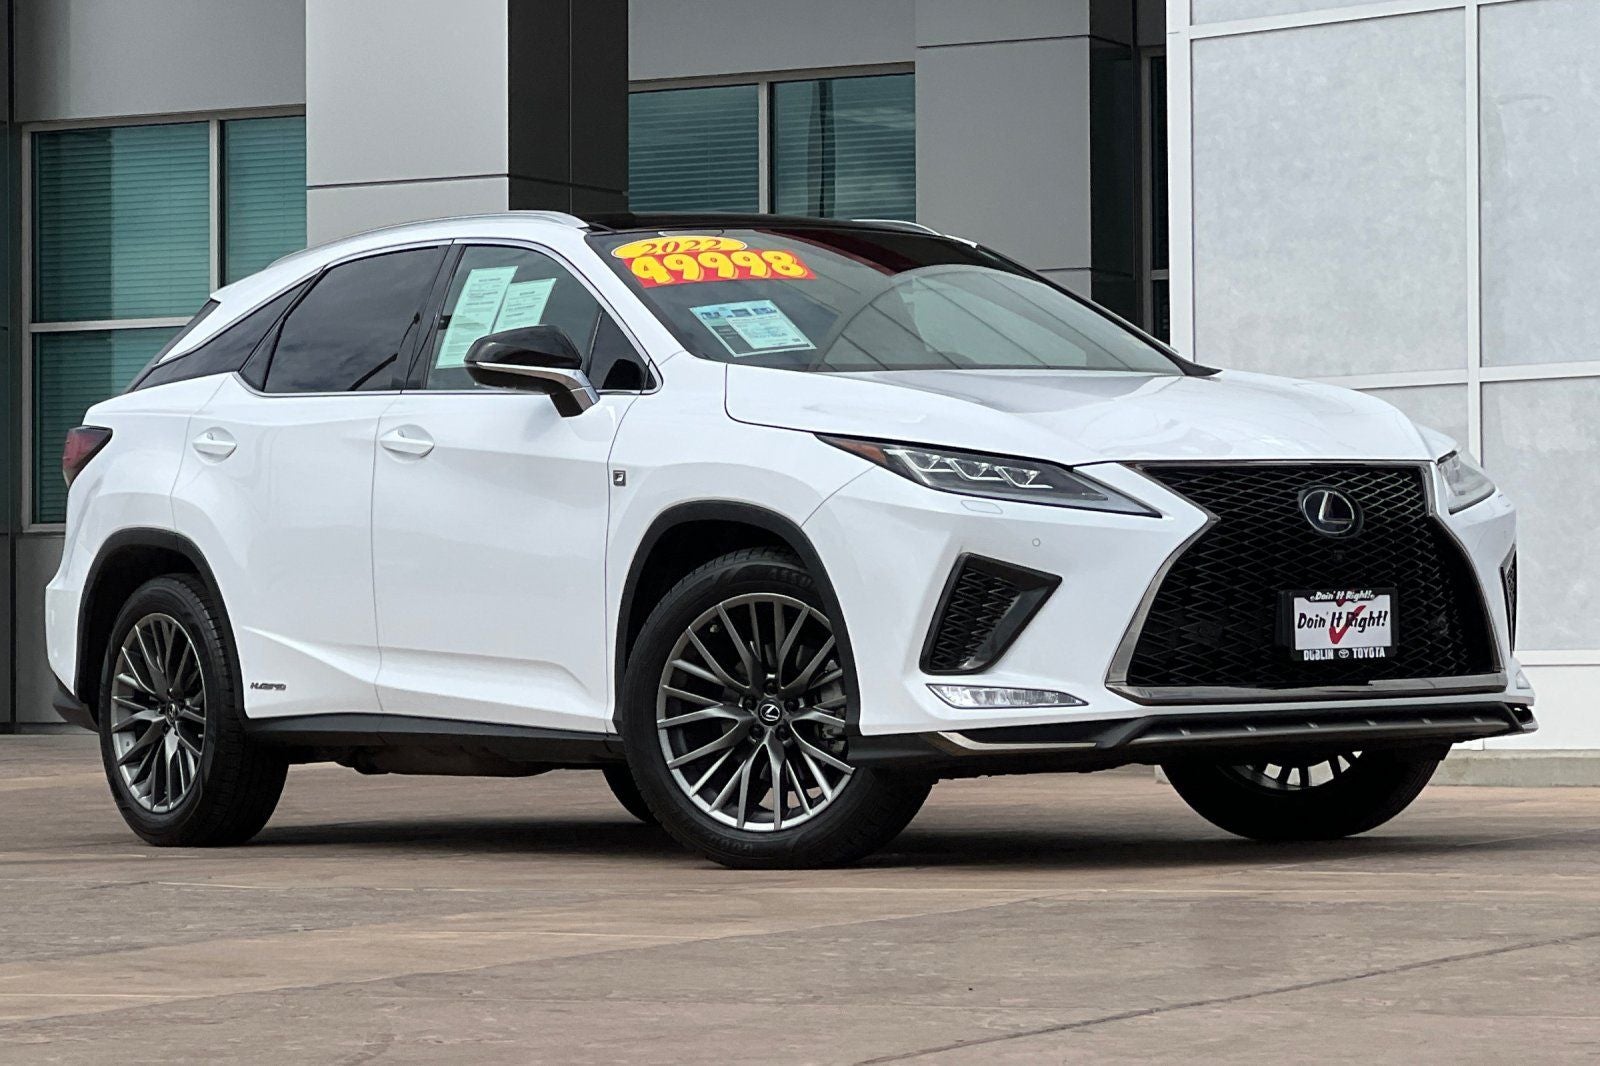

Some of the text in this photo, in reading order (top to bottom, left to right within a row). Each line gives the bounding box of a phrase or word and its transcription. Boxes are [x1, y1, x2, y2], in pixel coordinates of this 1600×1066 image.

[641, 239, 722, 254] 2022
[631, 250, 808, 284] 49998
[1297, 610, 1388, 633] Doin' It Right!
[1303, 647, 1385, 660] DUBLIN TOYOTA
